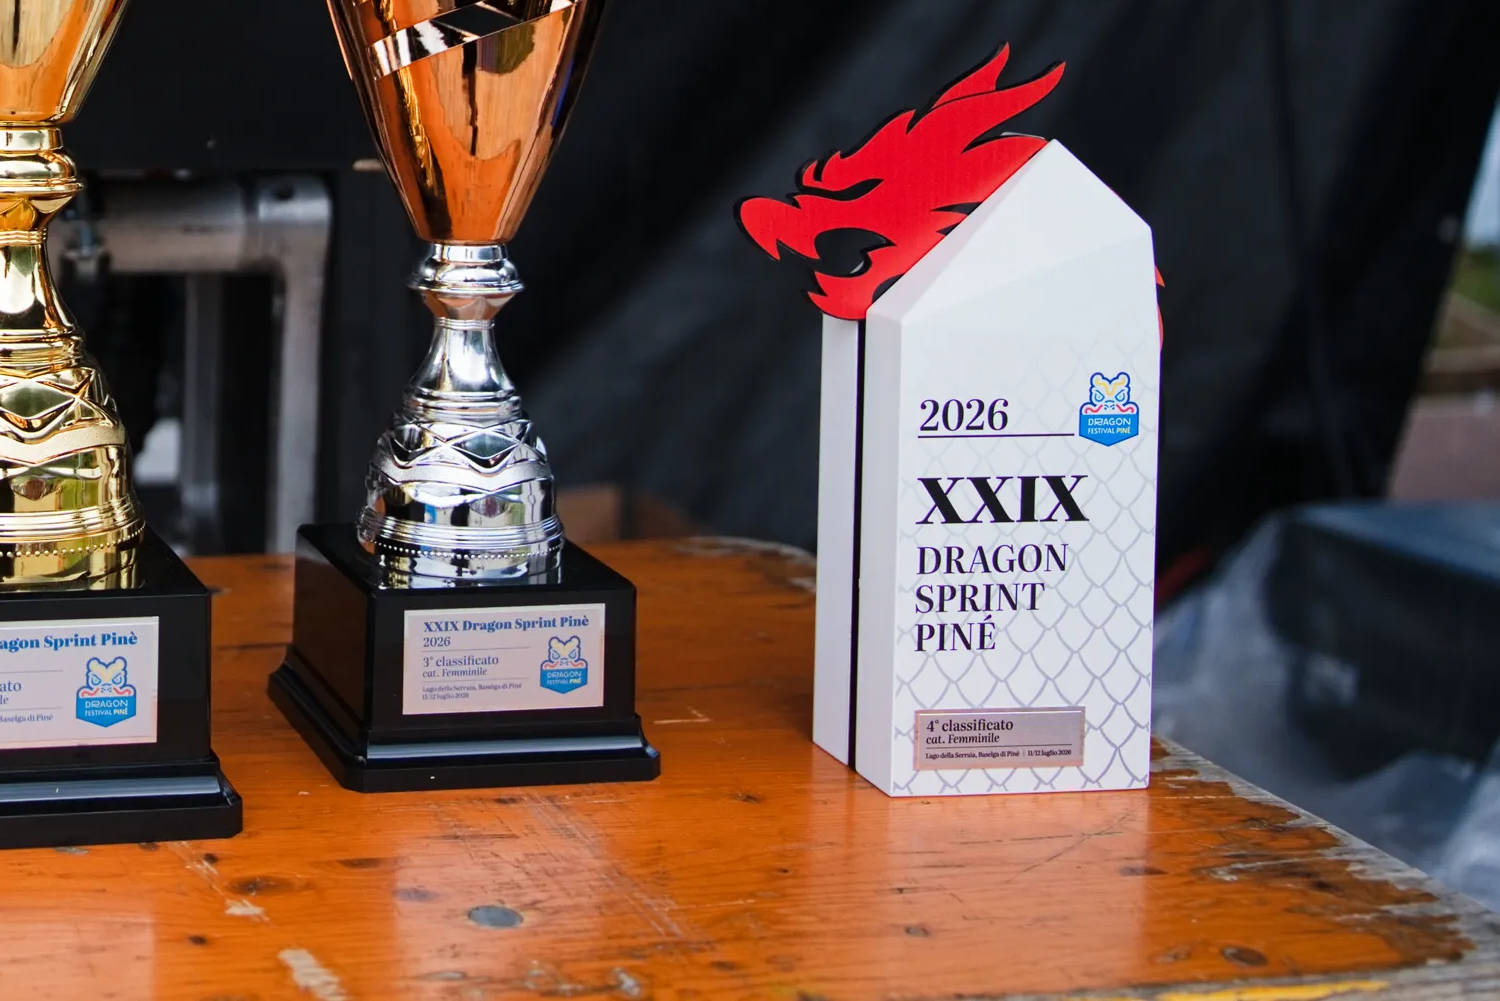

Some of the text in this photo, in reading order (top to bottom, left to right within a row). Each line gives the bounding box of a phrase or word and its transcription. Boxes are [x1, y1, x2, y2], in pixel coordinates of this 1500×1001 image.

[920, 398, 1009, 431] 2026
[1088, 417, 1131, 426] DRAGON
[915, 475, 1090, 524] XXIX
[916, 543, 1069, 575] DRAGON
[915, 582, 1045, 614] SPRINT
[423, 615, 589, 633] XXIX Dragon Sprint Pinè
[914, 614, 996, 652] PINÉ
[44, 633, 96, 651] Sprint
[101, 631, 138, 646] Pinè
[423, 637, 451, 648] 2026
[435, 655, 499, 667] classificato
[422, 667, 488, 678] cat. Femminile
[85, 700, 128, 709] DRAGON
[27, 714, 35, 722] di
[941, 718, 1014, 732] classificato
[926, 732, 1000, 745] cat. Femminile
[925, 752, 939, 760] Lago
[940, 751, 954, 759] della
[978, 750, 1000, 759] Baselga
